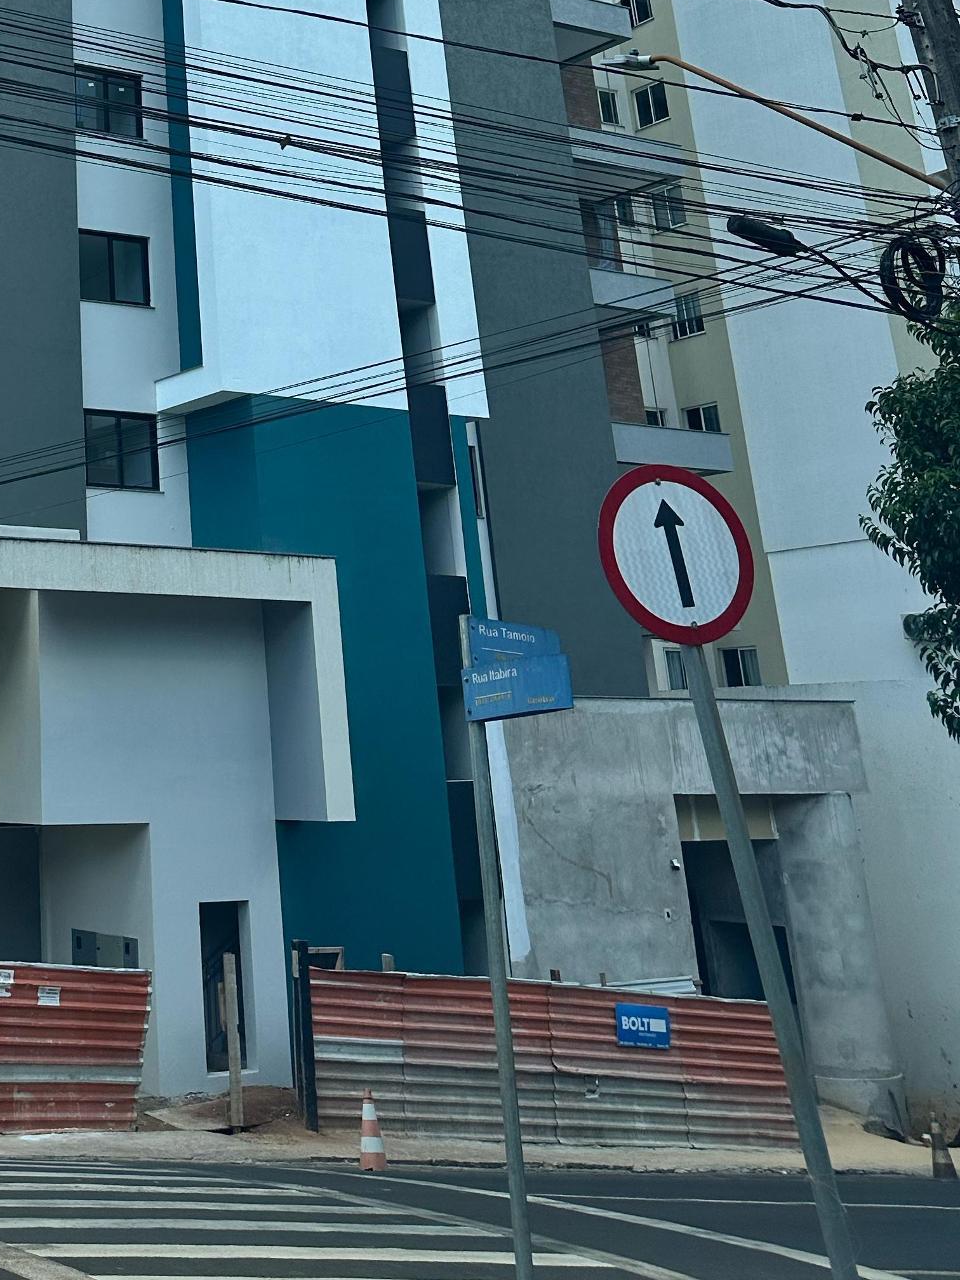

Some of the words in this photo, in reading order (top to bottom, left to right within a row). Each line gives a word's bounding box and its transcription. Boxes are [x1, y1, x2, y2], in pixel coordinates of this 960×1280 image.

[478, 624, 499, 638] Rua
[472, 672, 488, 684] Rua
[489, 667, 518, 681] Itabira
[621, 1015, 650, 1032] BOLT
